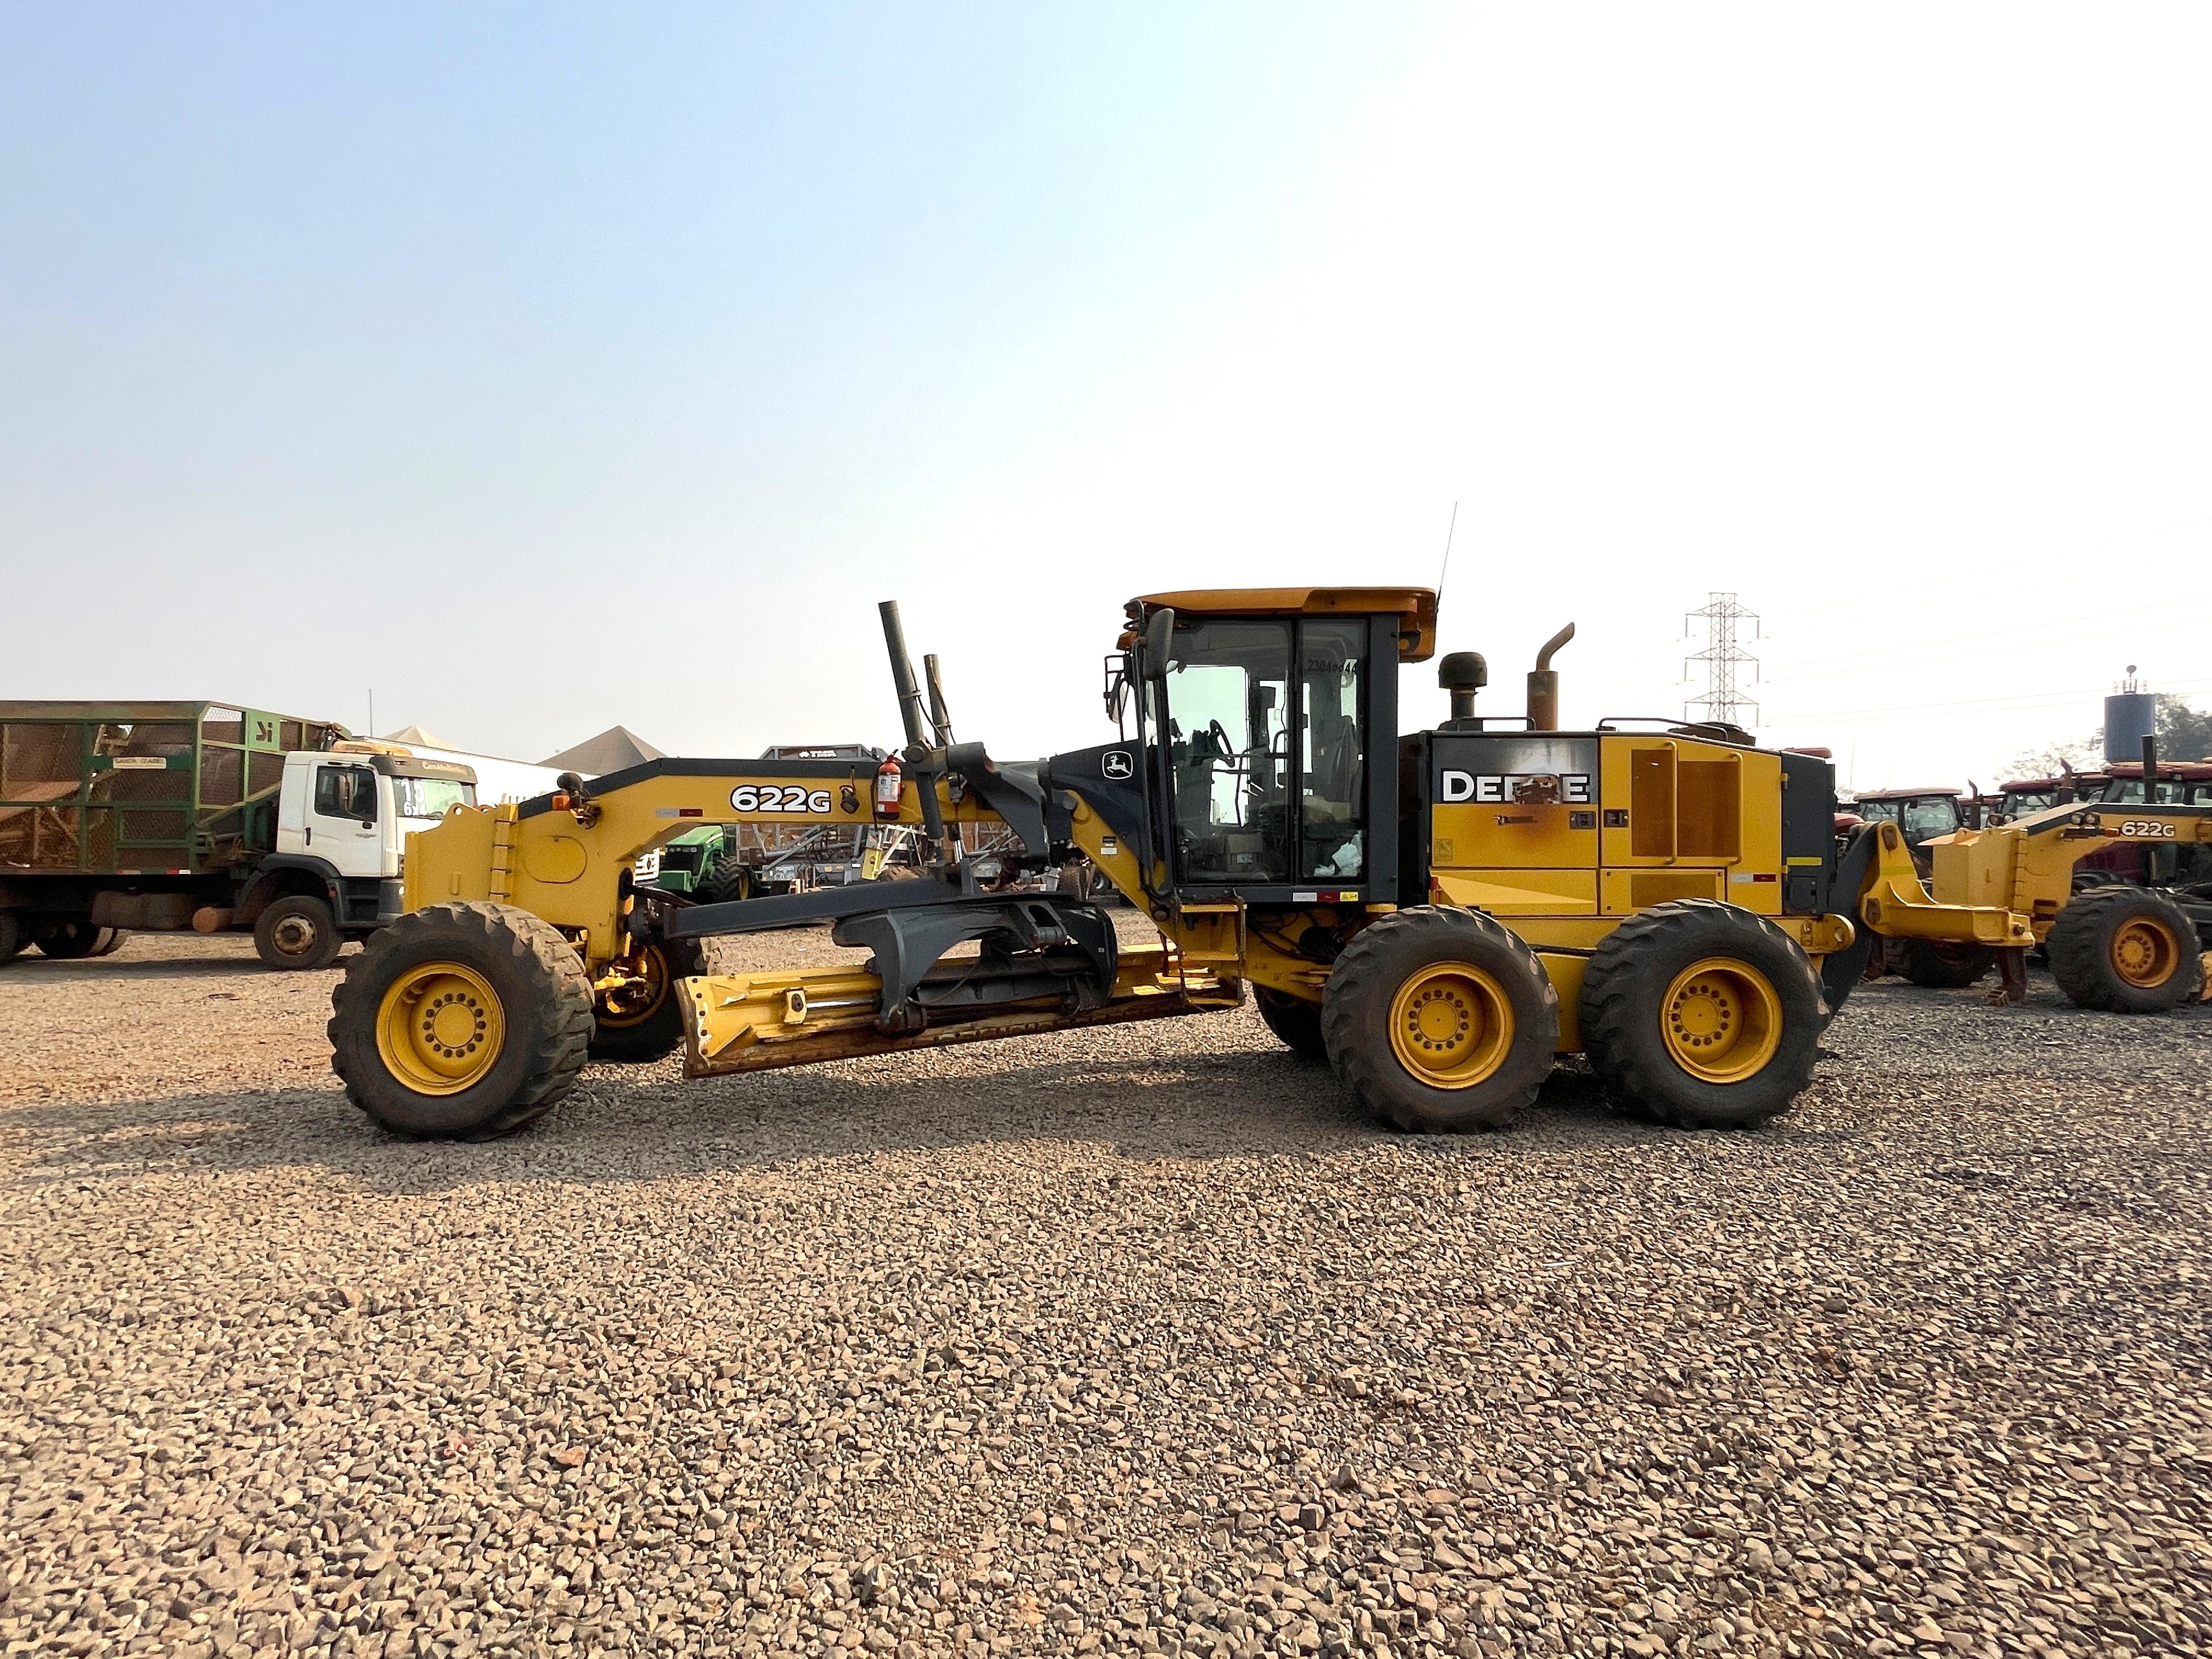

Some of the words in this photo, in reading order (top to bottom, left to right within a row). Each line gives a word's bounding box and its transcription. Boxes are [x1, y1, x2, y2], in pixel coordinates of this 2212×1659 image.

[730, 785, 831, 813] 622G
[1442, 770, 1588, 802] DEEE
[2121, 821, 2175, 838] 622G
